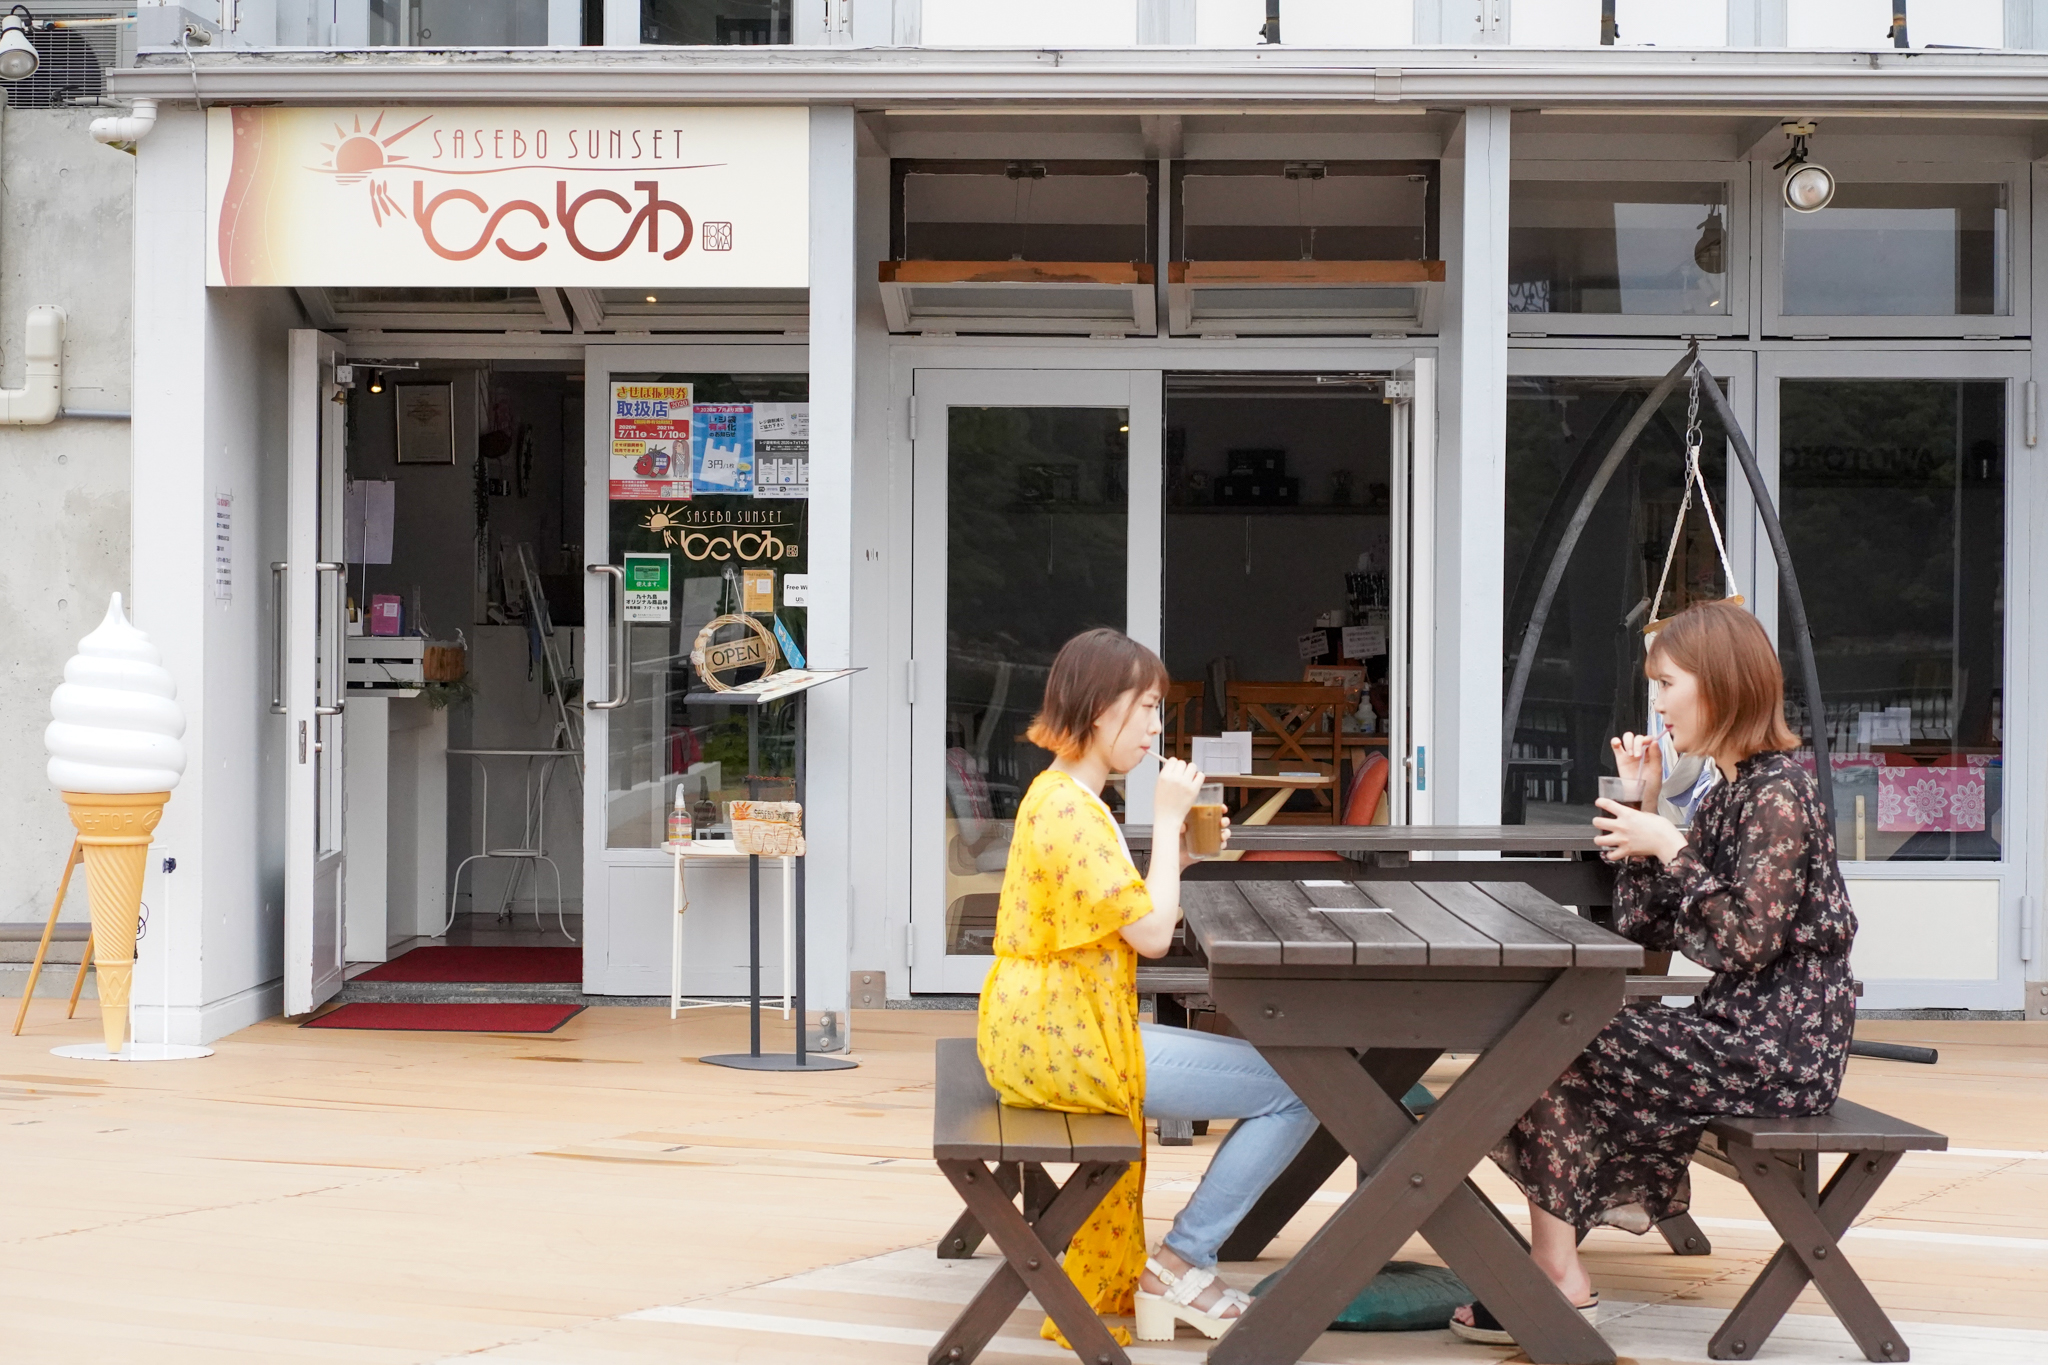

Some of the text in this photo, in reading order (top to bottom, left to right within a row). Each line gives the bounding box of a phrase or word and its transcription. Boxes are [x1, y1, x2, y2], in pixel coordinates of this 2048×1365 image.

[432, 129, 685, 160] SASEBO SUNSET
[413, 180, 694, 262] とことわ
[616, 400, 668, 418] 取扱店
[670, 400, 688, 409] 2020
[686, 510, 782, 523] SASEBO SUNSET
[681, 530, 785, 561] とことわ
[711, 643, 761, 666] OPEN
